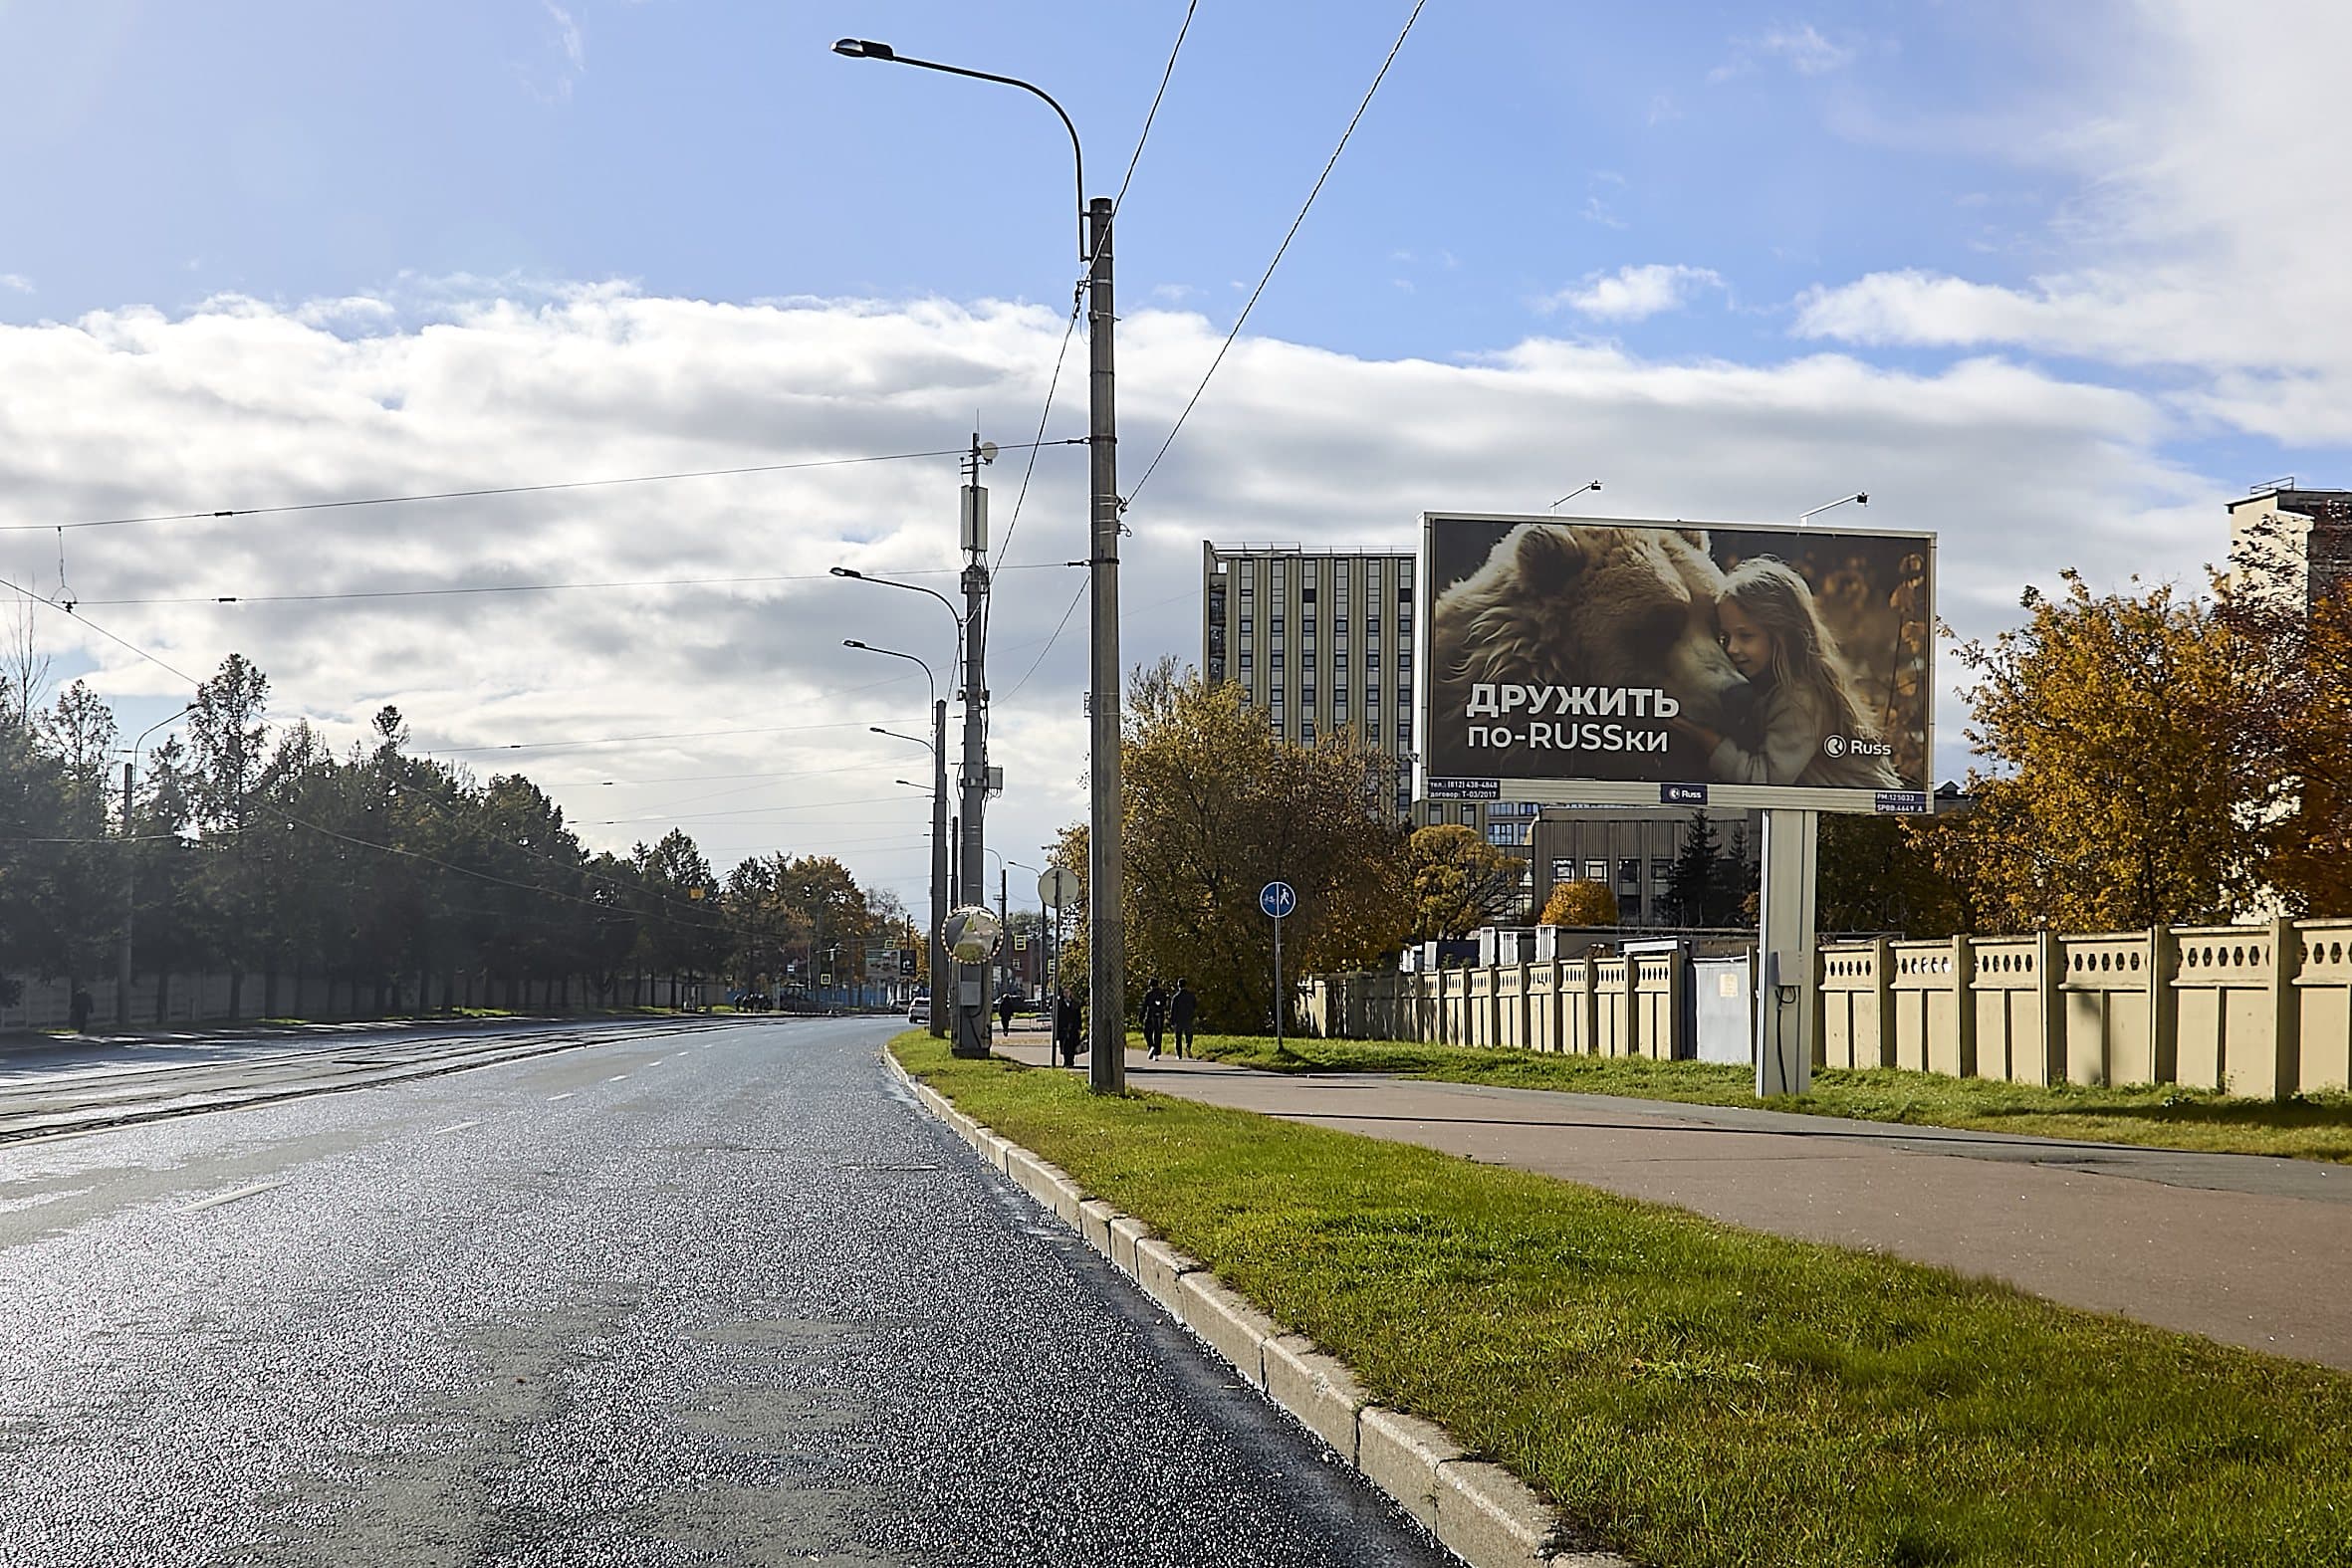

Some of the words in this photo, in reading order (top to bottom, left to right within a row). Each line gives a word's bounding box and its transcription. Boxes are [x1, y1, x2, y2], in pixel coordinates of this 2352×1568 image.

[1466, 683, 1681, 719] ДРУЖИТЬ
[1467, 722, 1669, 753] по-RUSSки
[1851, 740, 1892, 755] Russ
